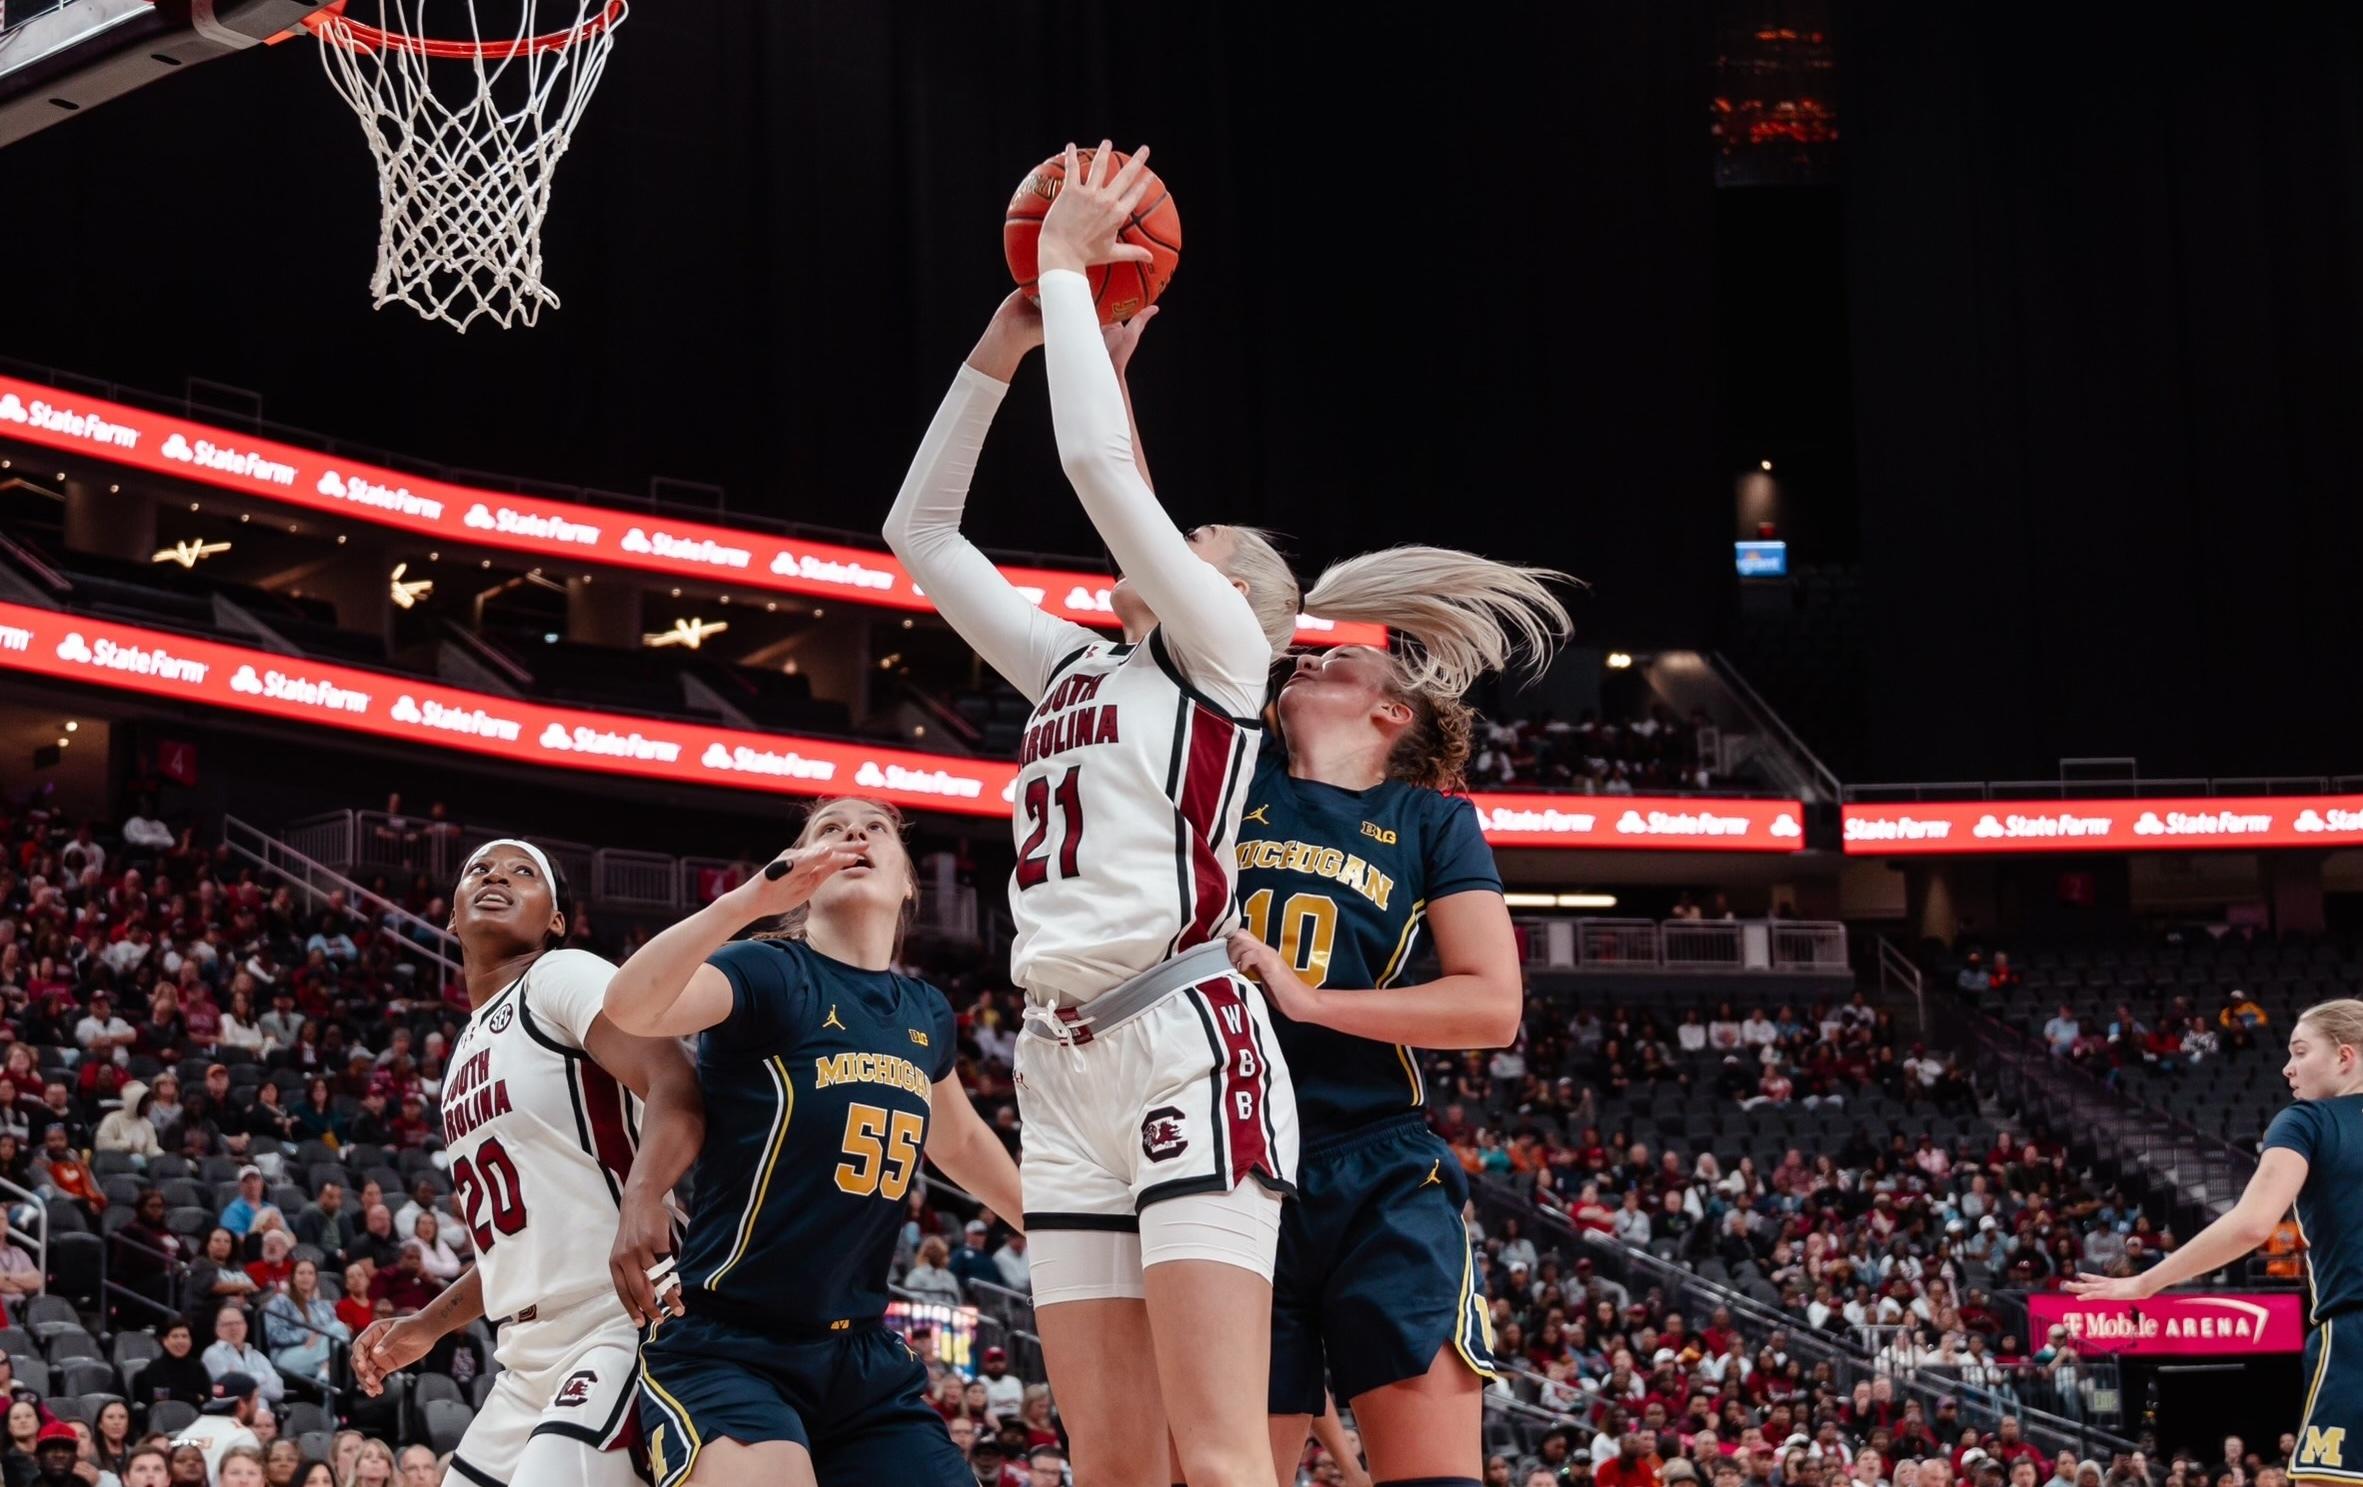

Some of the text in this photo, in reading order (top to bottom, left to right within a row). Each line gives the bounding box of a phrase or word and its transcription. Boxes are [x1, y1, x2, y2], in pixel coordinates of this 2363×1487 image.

[171, 749, 185, 776] 4
[1016, 765, 1084, 892] 21
[1243, 889, 1338, 989] 10
[815, 1052, 932, 1108] MICHIGA
[453, 1136, 527, 1256] 20
[834, 1102, 924, 1202] 55
[2165, 1317, 2251, 1338] ARENA
